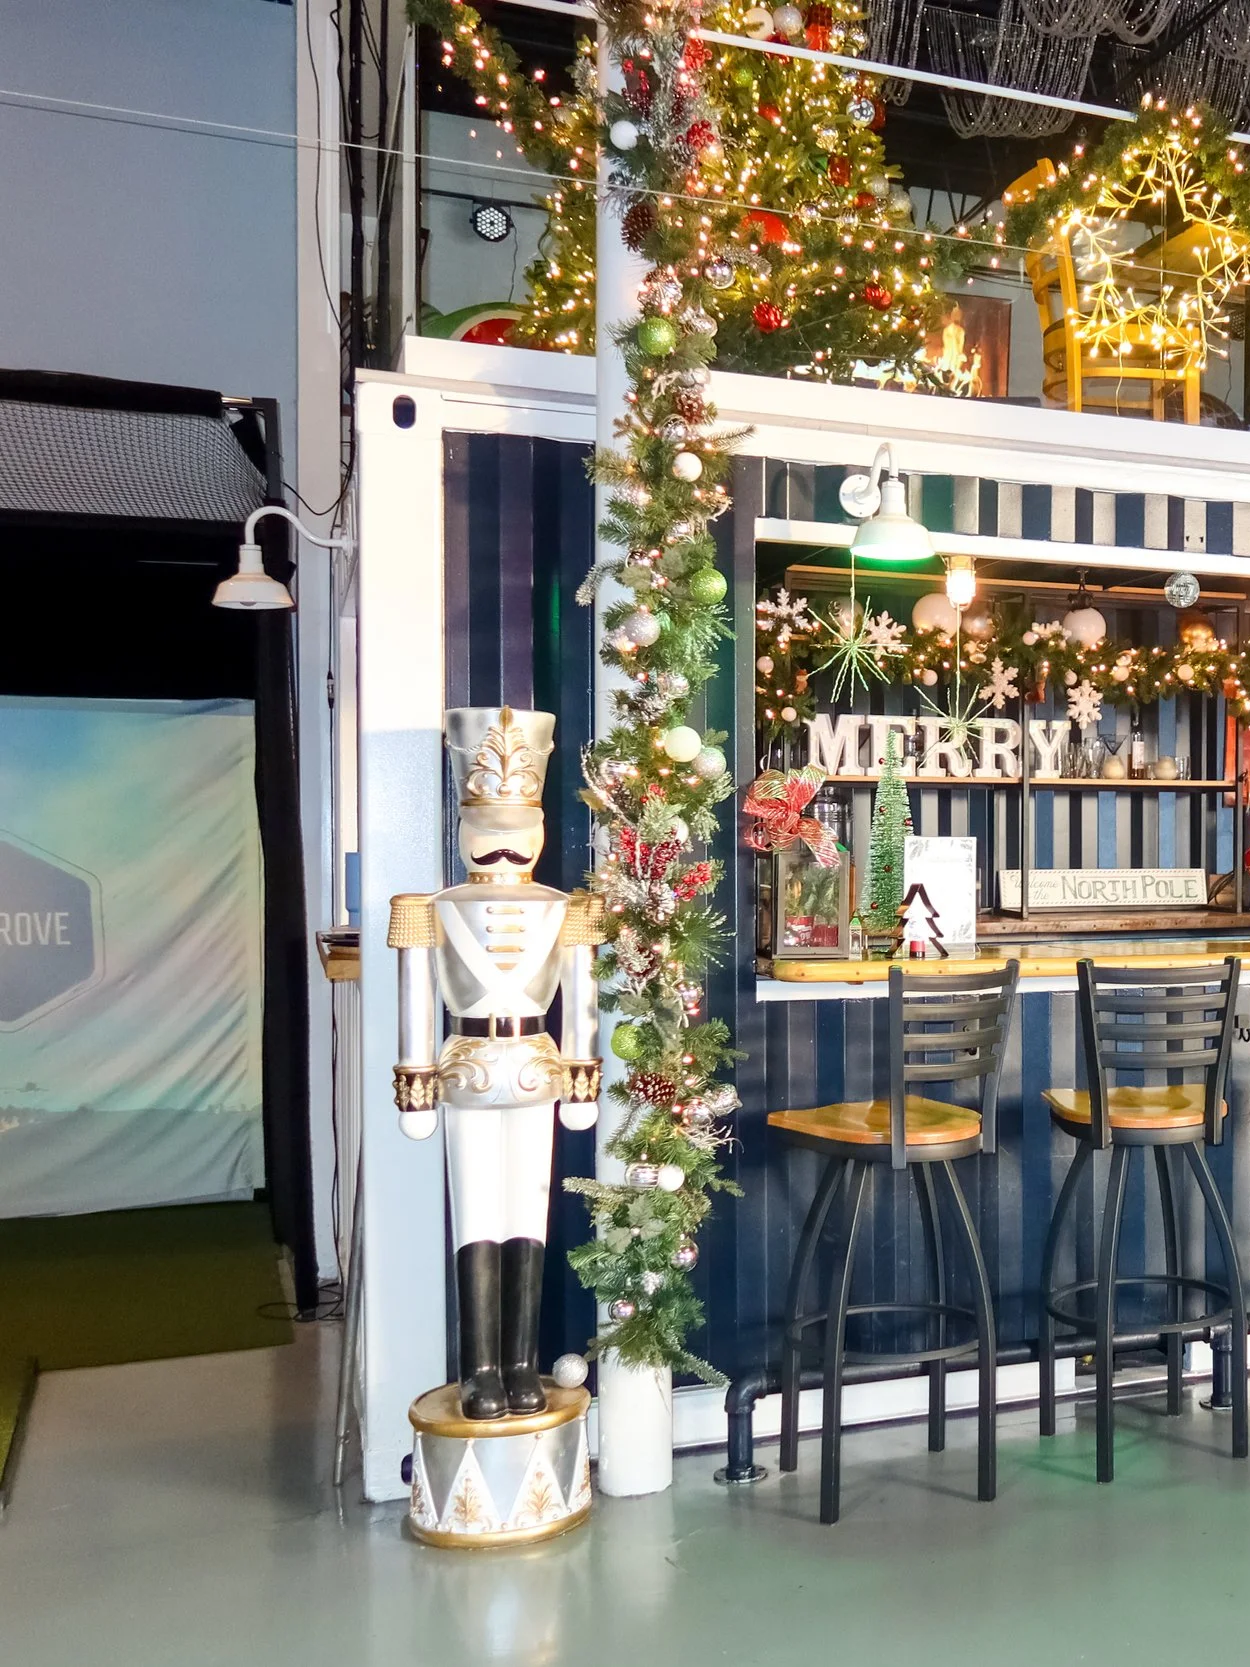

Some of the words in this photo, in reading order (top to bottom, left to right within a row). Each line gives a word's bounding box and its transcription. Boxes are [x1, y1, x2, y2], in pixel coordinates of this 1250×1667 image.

[803, 713, 1071, 779] MERRY
[1061, 875, 1138, 903] NORTH
[1141, 874, 1199, 900] POLE
[0, 911, 71, 945] ROVE
